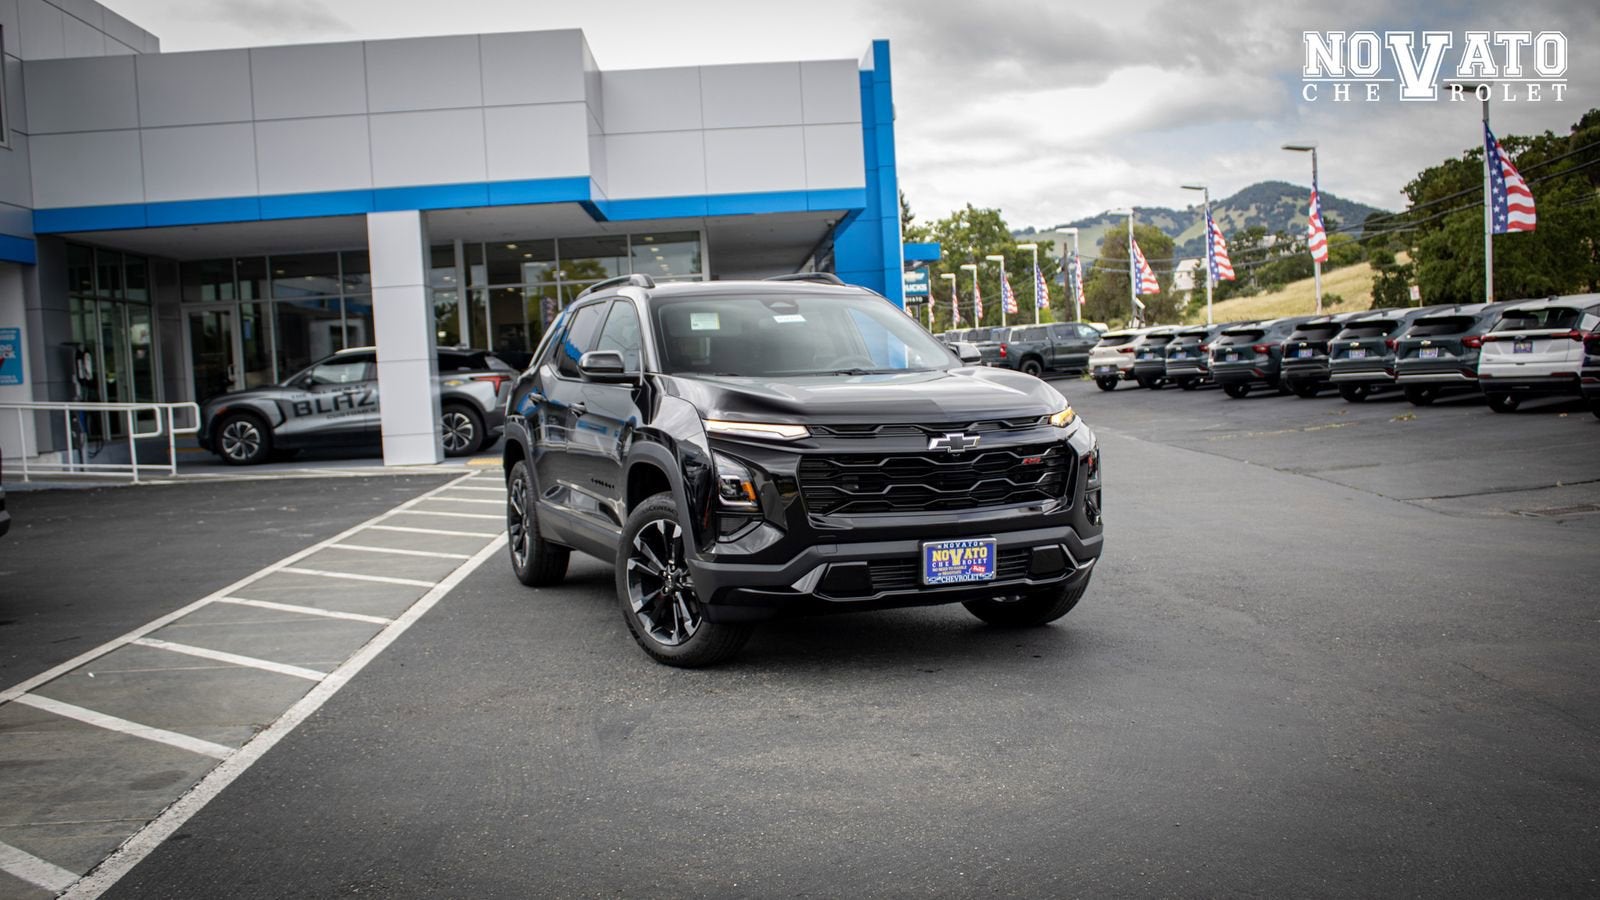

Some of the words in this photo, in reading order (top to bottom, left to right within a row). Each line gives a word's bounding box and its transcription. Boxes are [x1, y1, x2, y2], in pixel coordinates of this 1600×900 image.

[904, 284, 928, 292] UCKS
[292, 389, 376, 418] BLAZ
[932, 547, 988, 566] NOVATO
[941, 574, 979, 583] CHEVROLET
